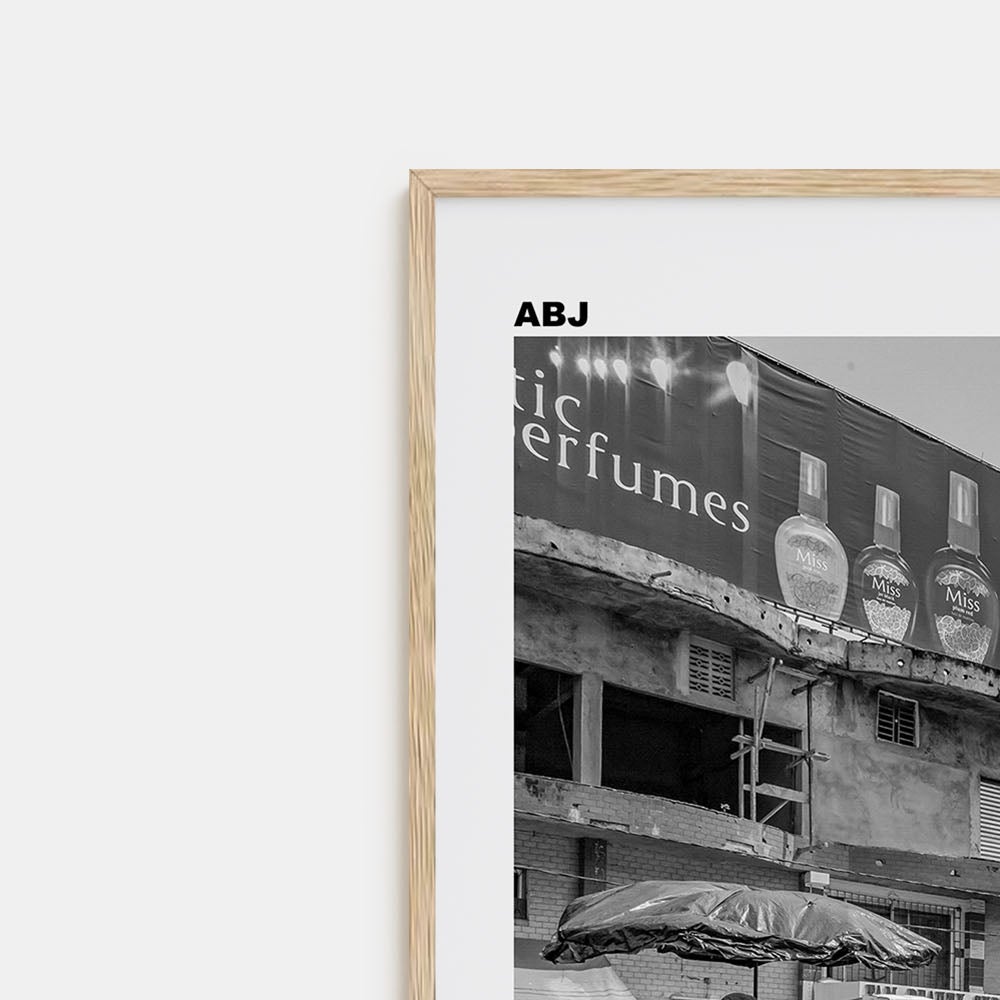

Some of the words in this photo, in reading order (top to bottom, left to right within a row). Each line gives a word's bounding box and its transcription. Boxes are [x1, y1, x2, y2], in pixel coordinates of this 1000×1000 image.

[513, 301, 590, 328] ABJ
[514, 421, 751, 534] erfumes
[795, 549, 829, 572] Miss
[871, 576, 901, 598] Miss
[945, 586, 981, 613] Miss
